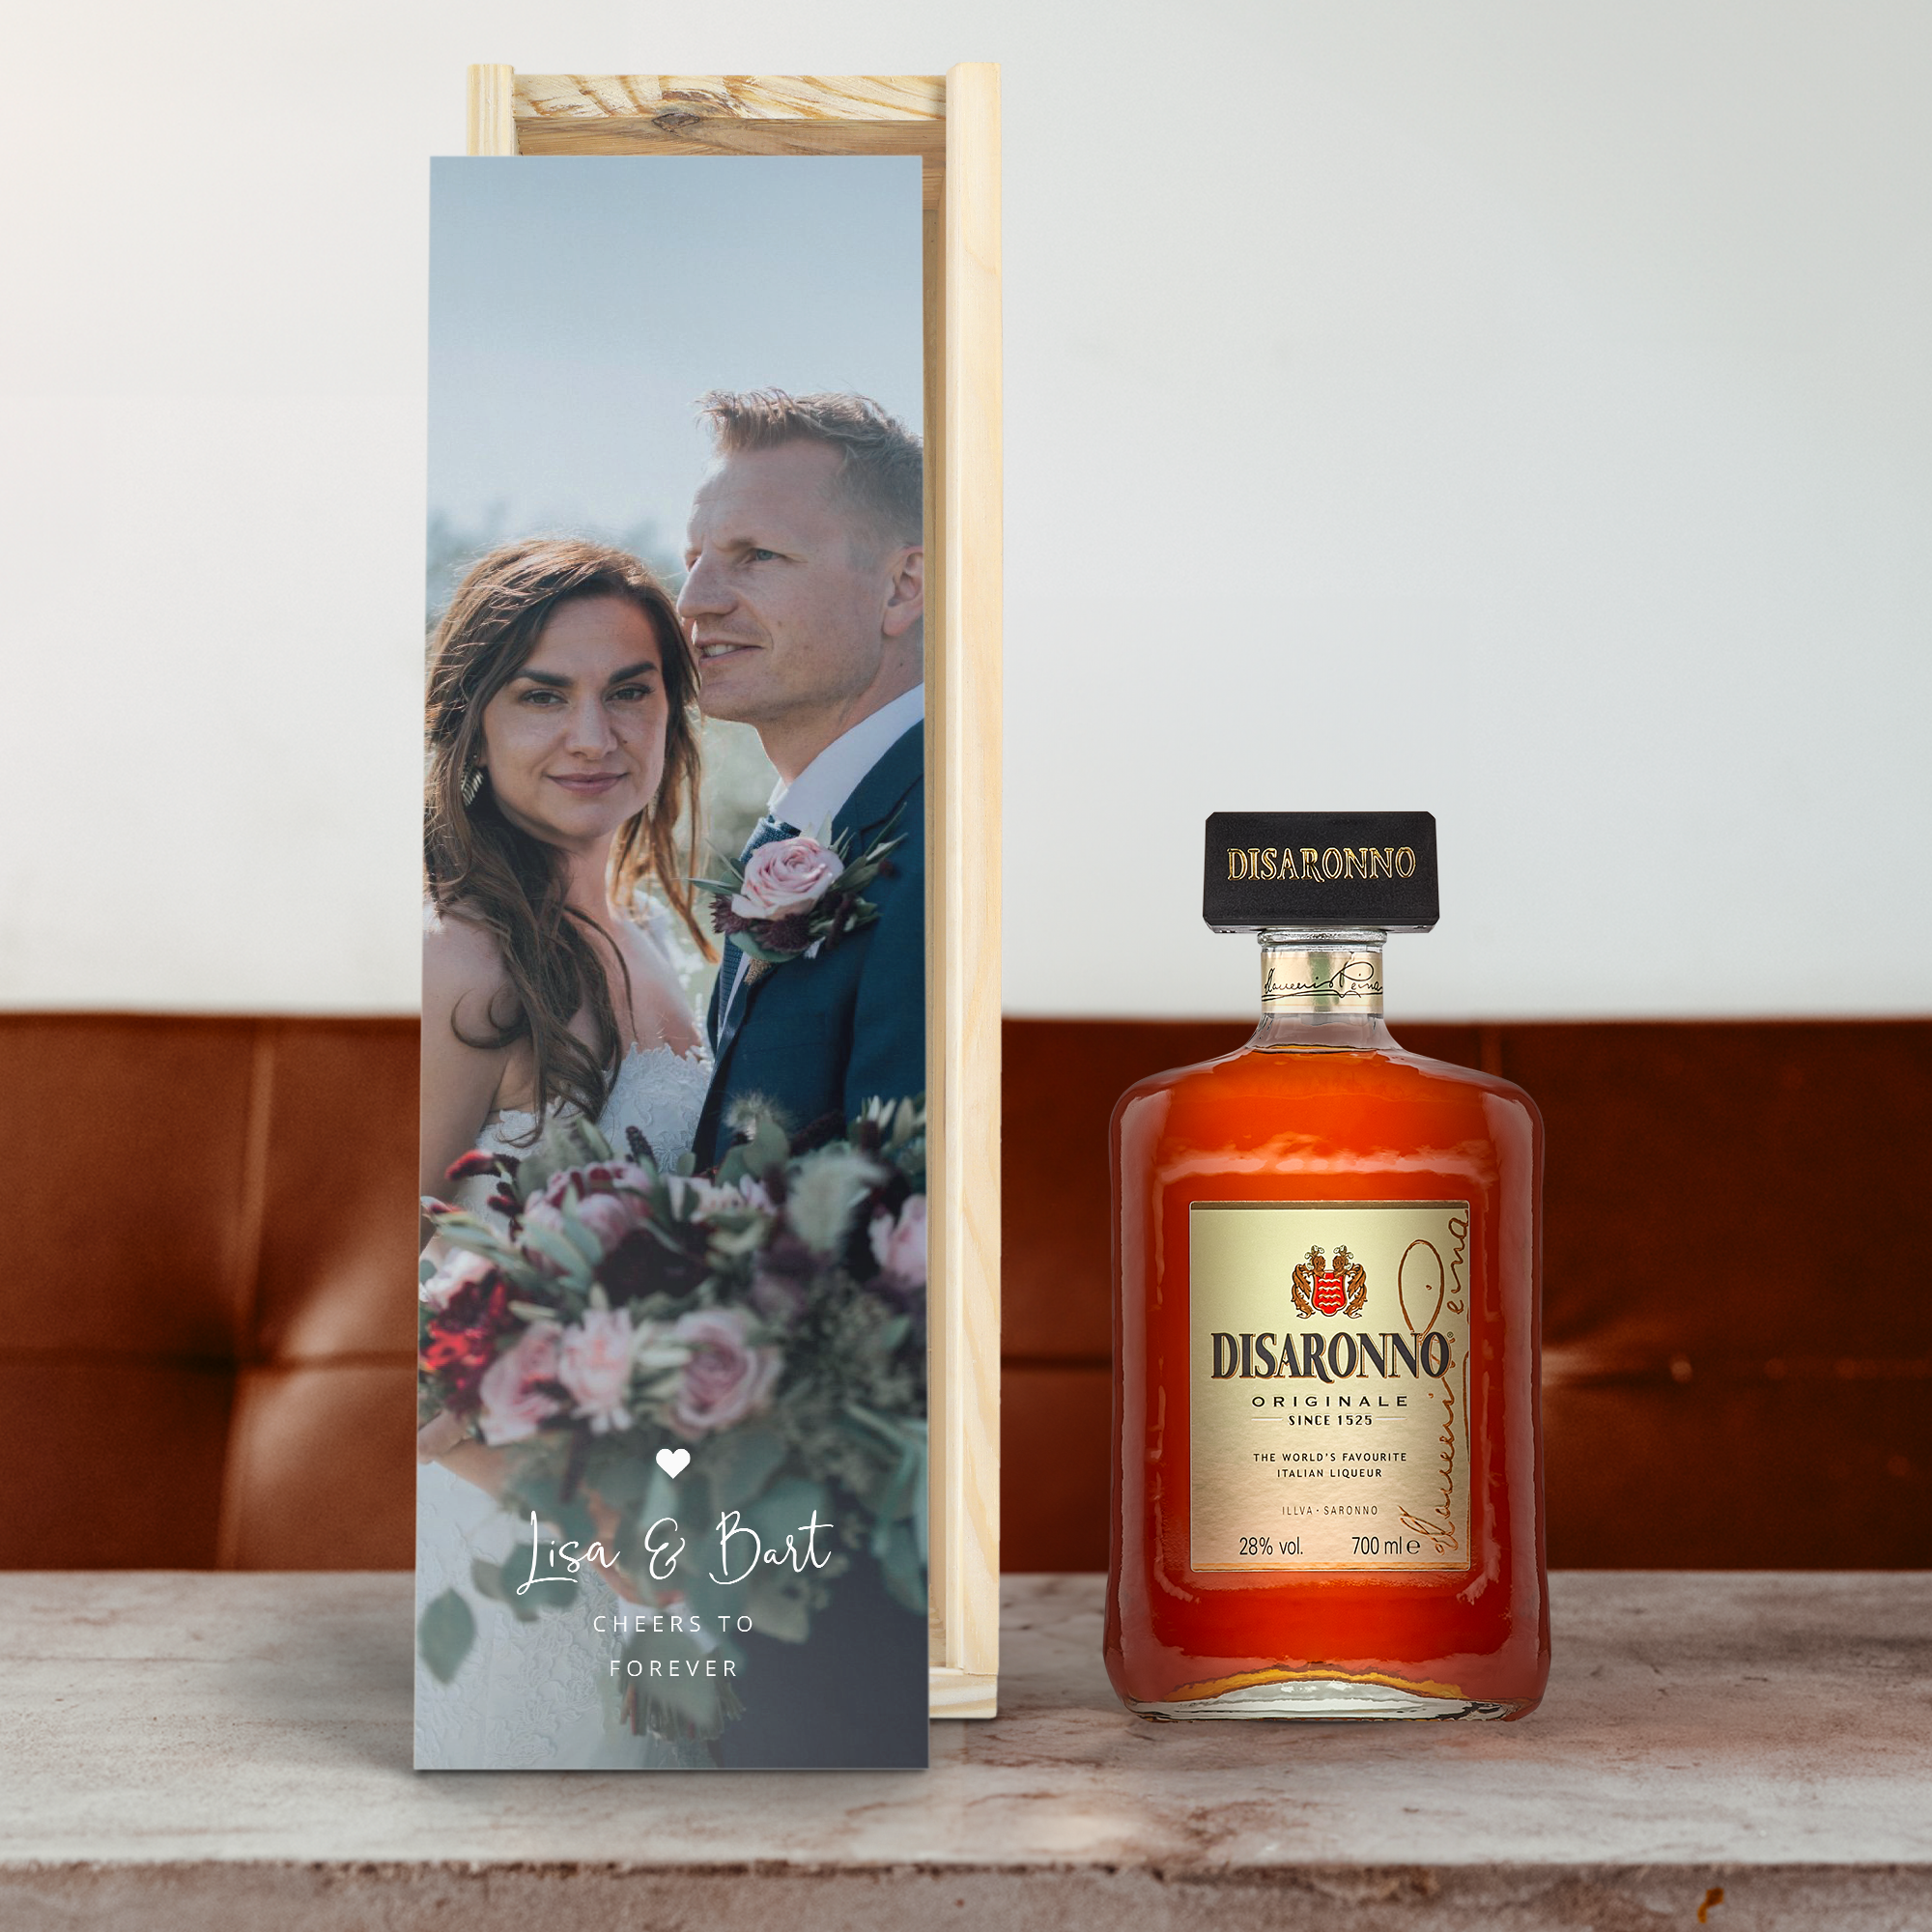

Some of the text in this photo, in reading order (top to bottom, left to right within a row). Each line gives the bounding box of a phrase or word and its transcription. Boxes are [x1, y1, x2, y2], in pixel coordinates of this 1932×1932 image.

[1227, 846, 1417, 883] DISARONNO
[1210, 1331, 1452, 1384] DISARONNO
[1251, 1396, 1407, 1407] ORIGINALE
[1288, 1414, 1373, 1426] SINCE 1525
[1253, 1452, 1407, 1463] THE WORLD'S FAVOURITE
[1277, 1468, 1382, 1478] ITALIAN LIQUEUR
[1282, 1506, 1378, 1516] ILLVA SARONNO
[516, 1509, 834, 1595] Lisa & Bart
[1238, 1537, 1303, 1555] 28% vol.
[1351, 1536, 1379, 1555] 700
[593, 1615, 753, 1633] CHEERS TO
[610, 1660, 736, 1677] FOREVER
